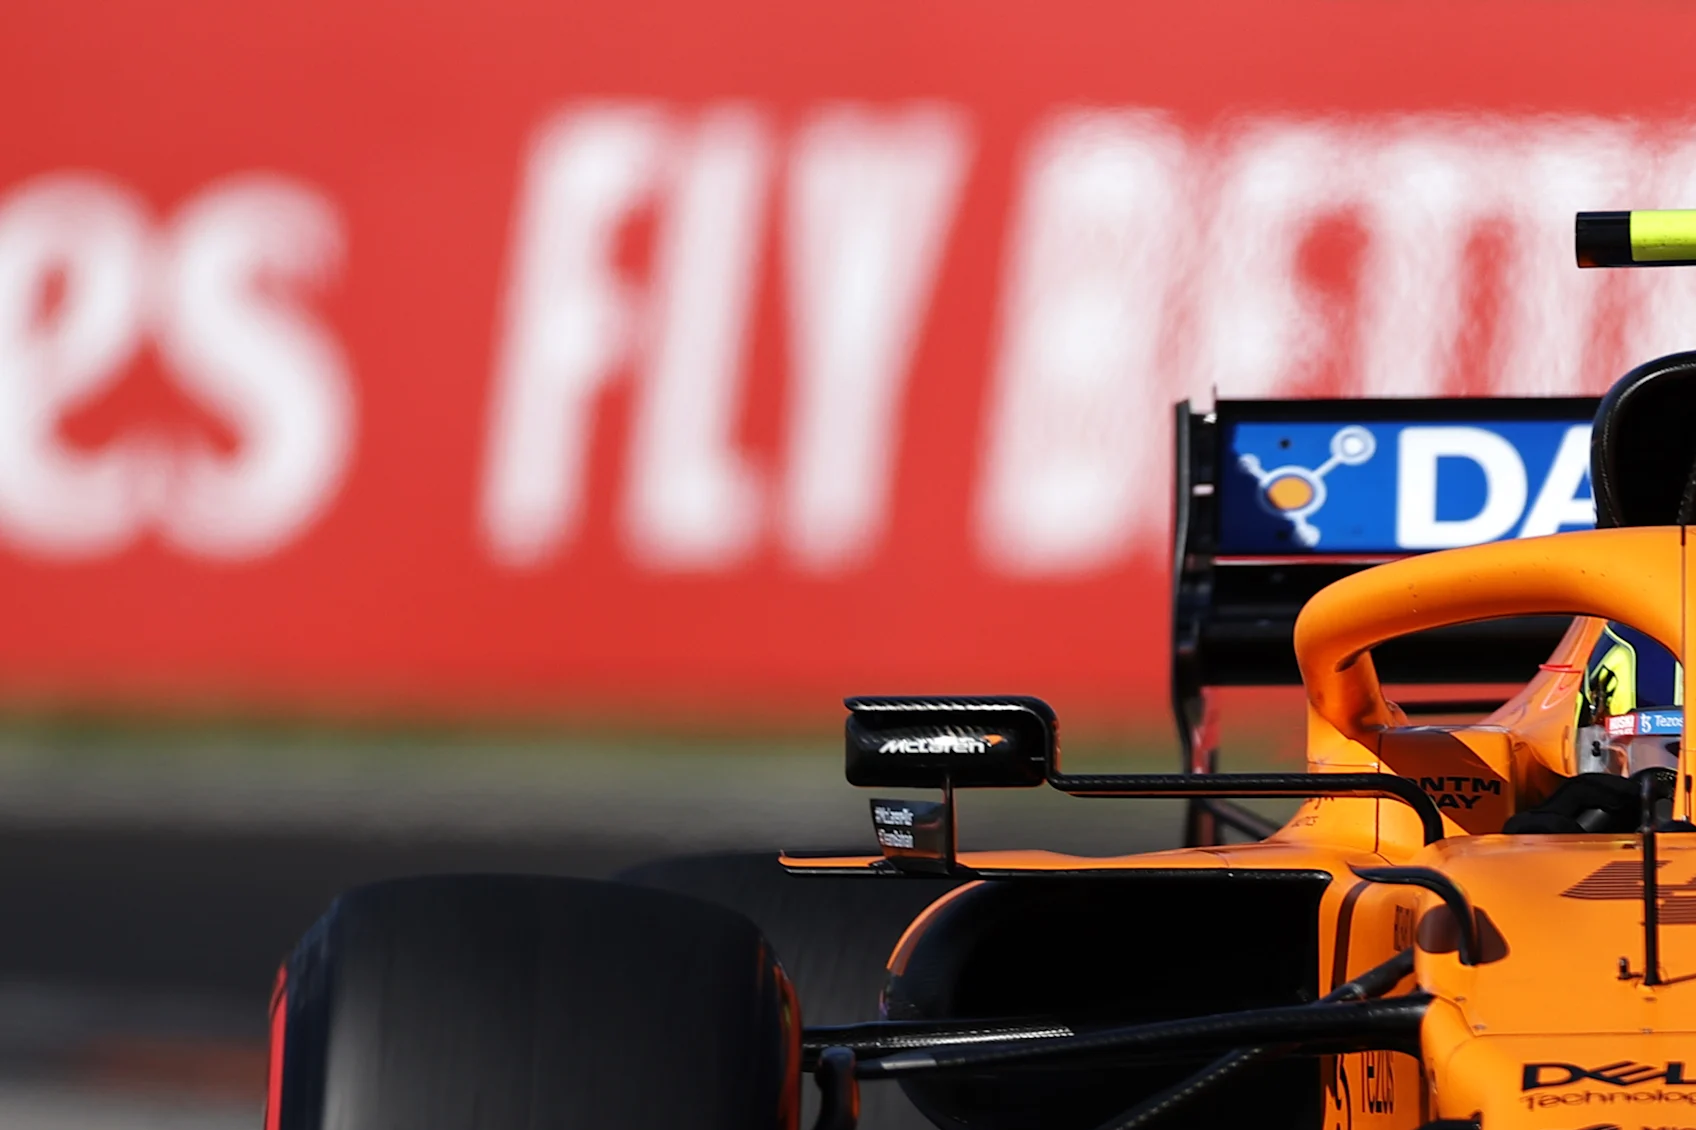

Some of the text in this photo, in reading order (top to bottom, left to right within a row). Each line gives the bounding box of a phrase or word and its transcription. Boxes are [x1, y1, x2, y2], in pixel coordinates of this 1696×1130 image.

[478, 96, 976, 576] FLY
[878, 735, 986, 754] McLaren
[1410, 777, 1501, 795] NTM
[1429, 795, 1483, 810] AY
